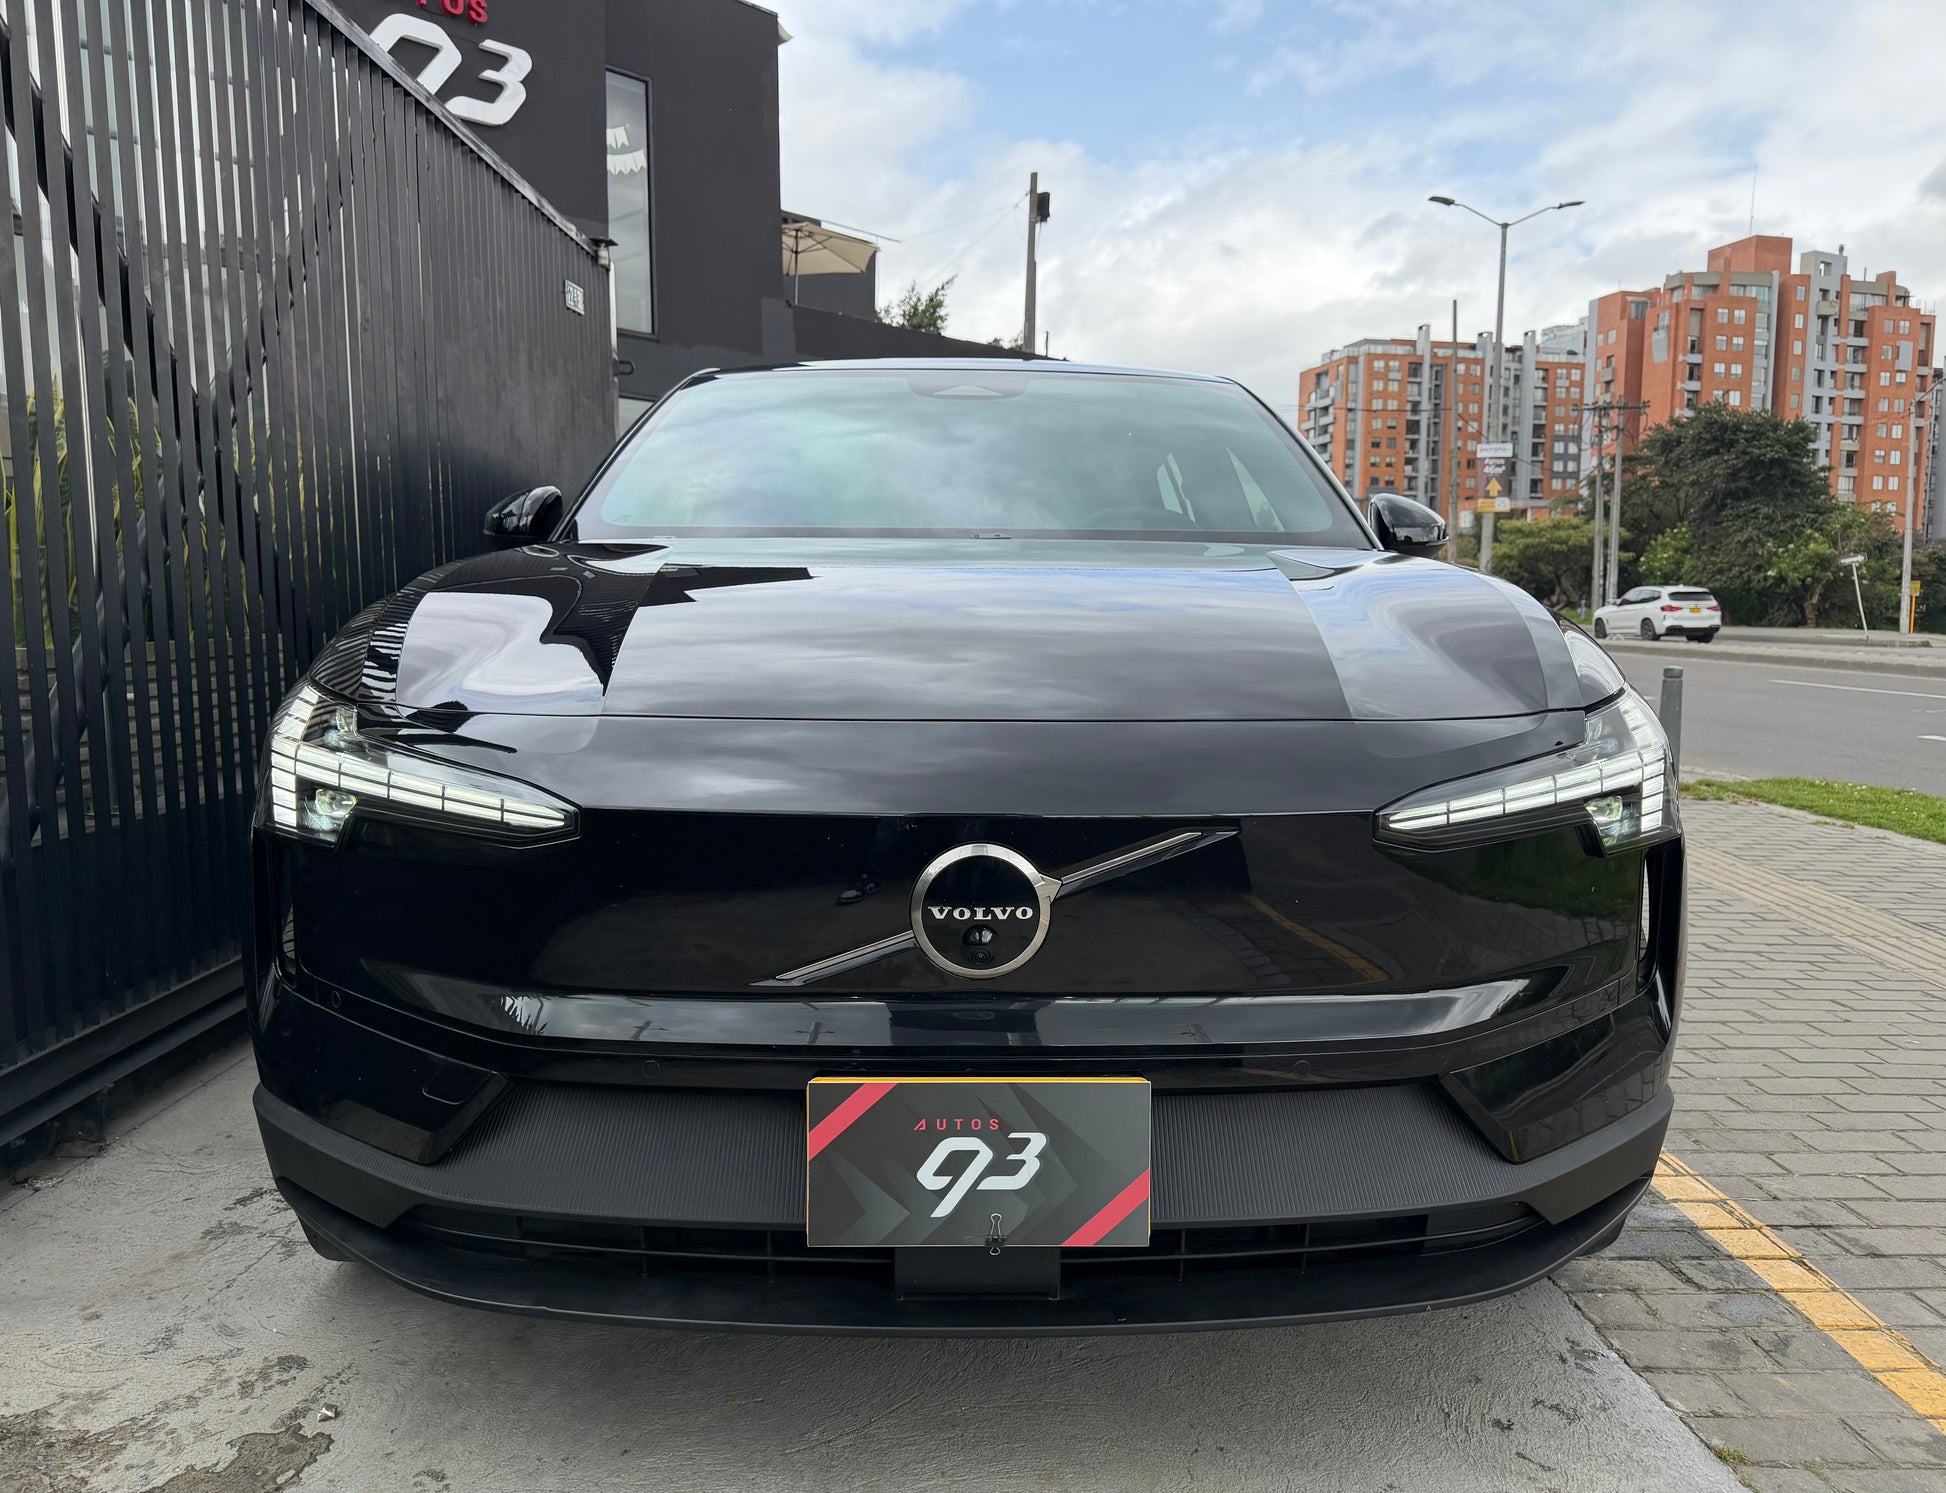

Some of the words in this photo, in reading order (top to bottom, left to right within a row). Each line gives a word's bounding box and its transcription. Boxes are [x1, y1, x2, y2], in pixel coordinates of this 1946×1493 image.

[415, 0, 488, 24] OS
[927, 906, 1034, 920] VOLVO
[913, 1118, 999, 1131] AUTOS
[916, 1132, 1047, 1218] 93
